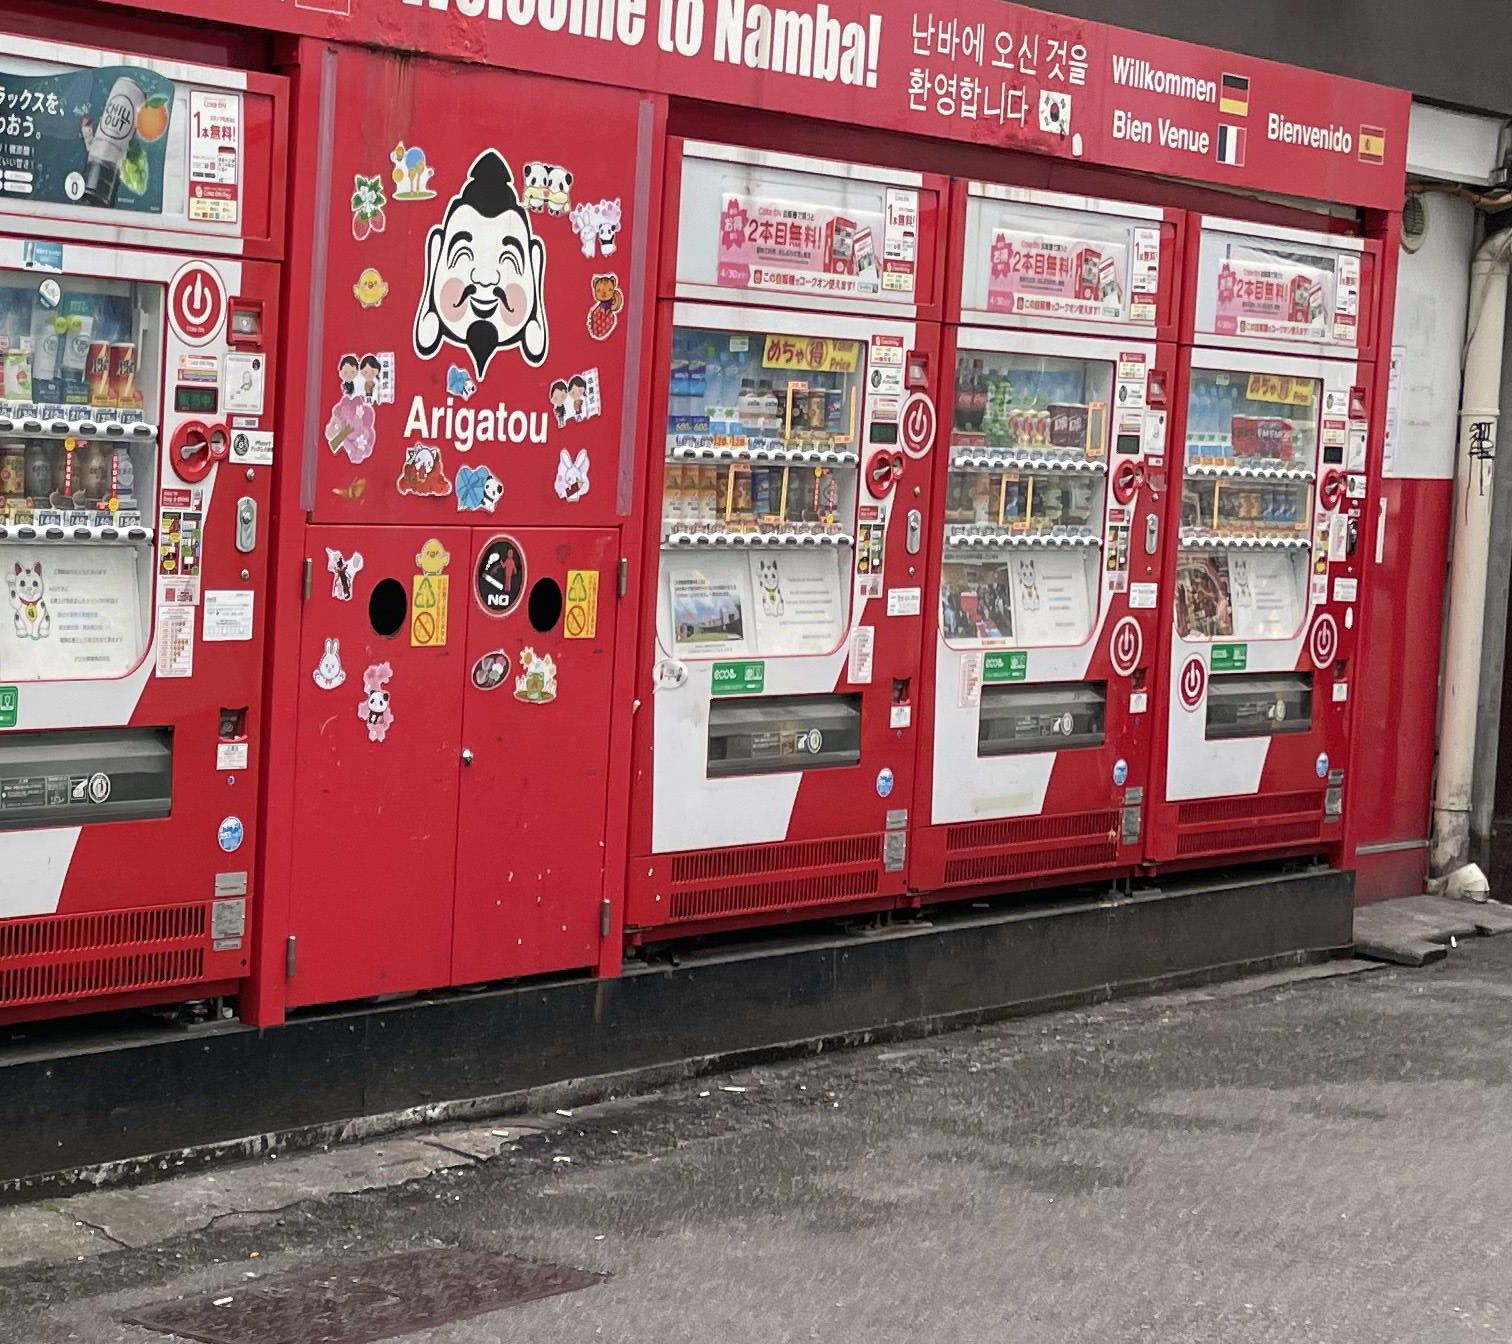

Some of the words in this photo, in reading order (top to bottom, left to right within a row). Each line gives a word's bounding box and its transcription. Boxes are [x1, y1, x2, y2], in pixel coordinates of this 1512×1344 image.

[911, 13, 985, 66] 난바에
[991, 30, 1038, 76] 오신
[1046, 39, 1088, 86] 것을
[908, 68, 1029, 127] 환영합니다
[1112, 54, 1217, 104] Willkommen
[104, 116, 126, 131] OUT
[1113, 109, 1152, 145] Bien
[1158, 116, 1210, 154] Venue
[1267, 112, 1353, 154] Bienvenido
[403, 395, 549, 452] Arigatou
[488, 593, 510, 606] NO
